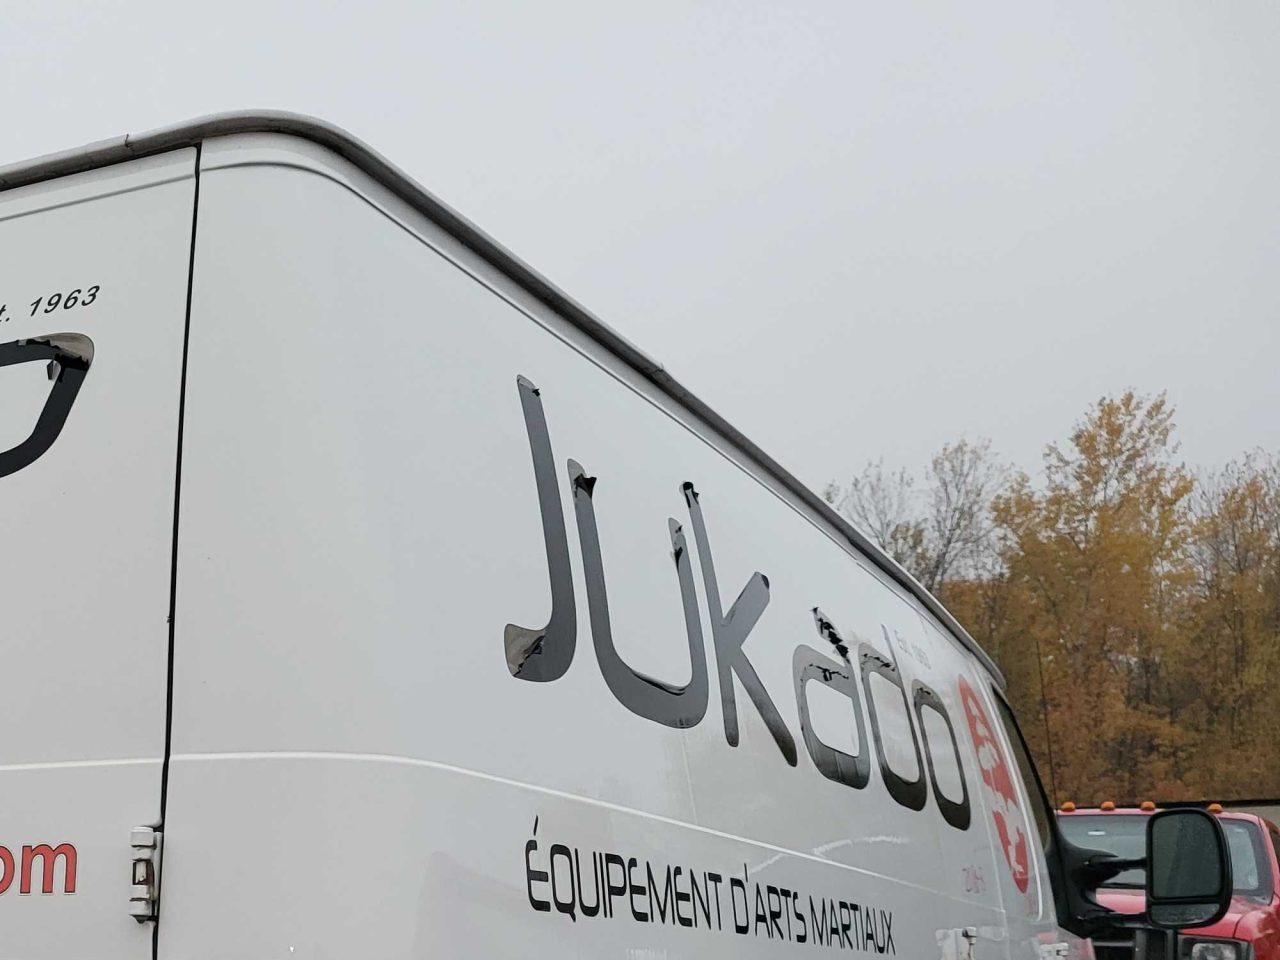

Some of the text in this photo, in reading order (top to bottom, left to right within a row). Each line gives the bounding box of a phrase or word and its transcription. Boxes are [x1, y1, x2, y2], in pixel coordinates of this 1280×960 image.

[29, 285, 101, 317] 1963
[525, 815, 896, 956] ÉQUIPEMENT D'ARTS MARTIAUX
